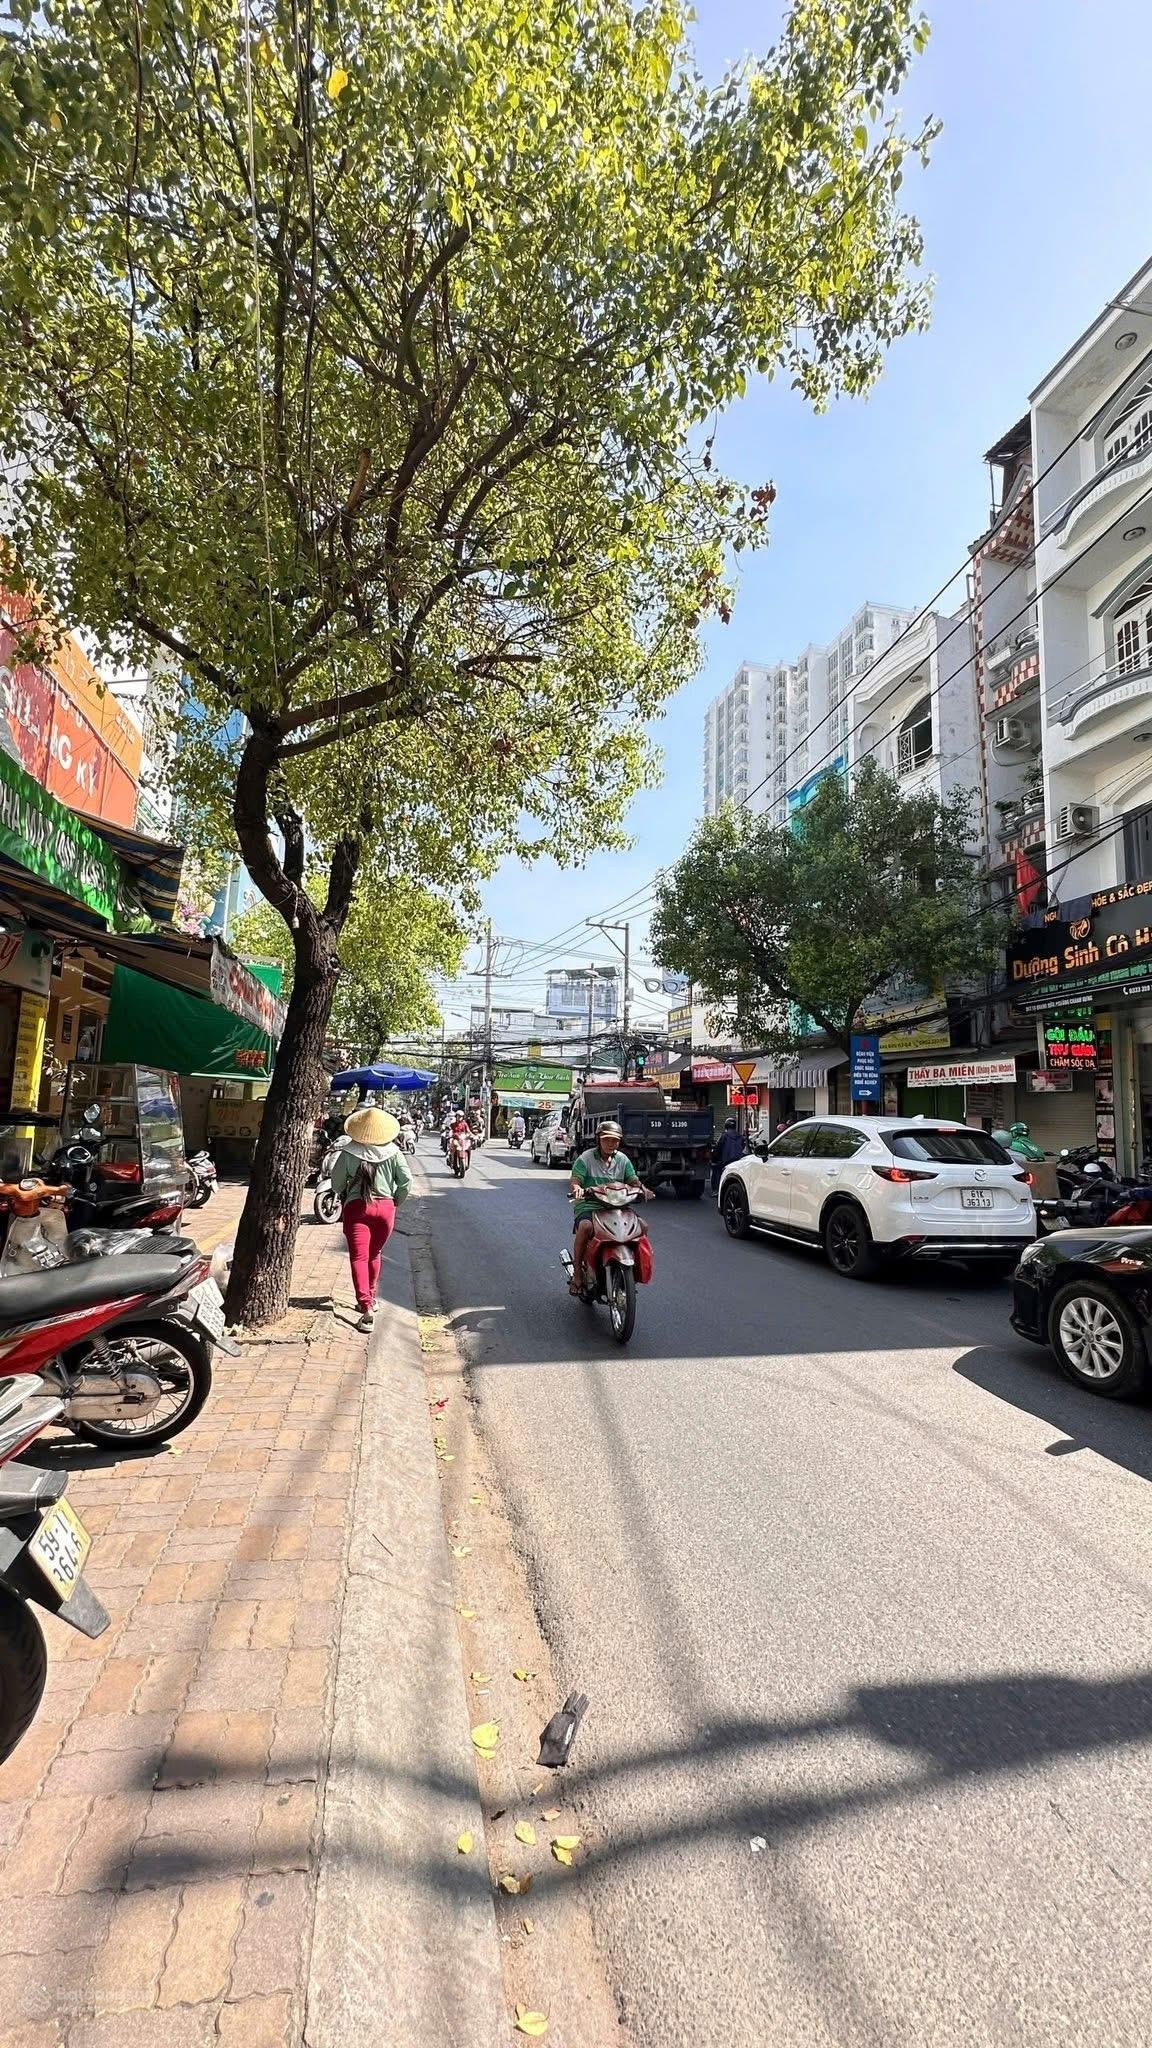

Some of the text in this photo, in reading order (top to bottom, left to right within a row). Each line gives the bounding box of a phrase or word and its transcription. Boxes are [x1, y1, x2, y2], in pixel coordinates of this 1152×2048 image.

[1064, 941, 1100, 969] Sinh
[1106, 935, 1129, 957] Cô
[1135, 927, 1152, 946] H
[1071, 1058, 1084, 1068] SÓC
[1085, 1059, 1095, 1067] DA
[933, 1069, 946, 1077] BA
[970, 1190, 984, 1198] 61K
